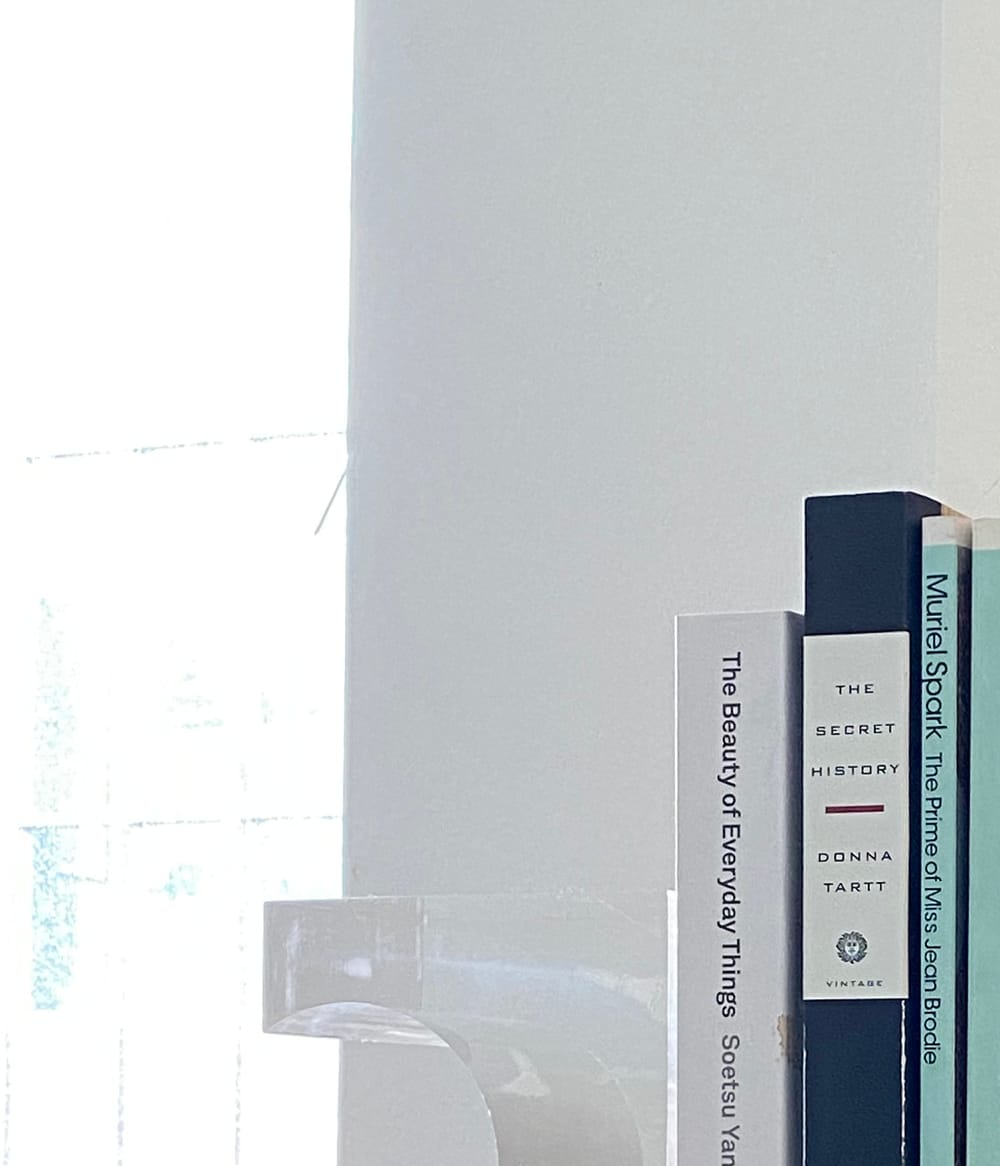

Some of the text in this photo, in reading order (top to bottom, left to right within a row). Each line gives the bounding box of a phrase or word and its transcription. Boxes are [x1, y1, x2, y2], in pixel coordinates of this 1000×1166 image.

[721, 651, 742, 696] The
[835, 683, 875, 695] THE
[815, 722, 896, 737] SECRET
[717, 702, 742, 787] Beauty
[811, 763, 900, 777] HISTORY
[721, 792, 742, 819] of
[921, 574, 949, 1065] Muriel Spark The Prime of Miss Jean Brodie
[818, 850, 893, 864] DONNA
[717, 824, 742, 935] Everyday
[824, 880, 886, 893] TARTT
[717, 938, 742, 1018] Things
[826, 980, 884, 988] VINTAGE
[721, 1034, 741, 1118] Soetsu
